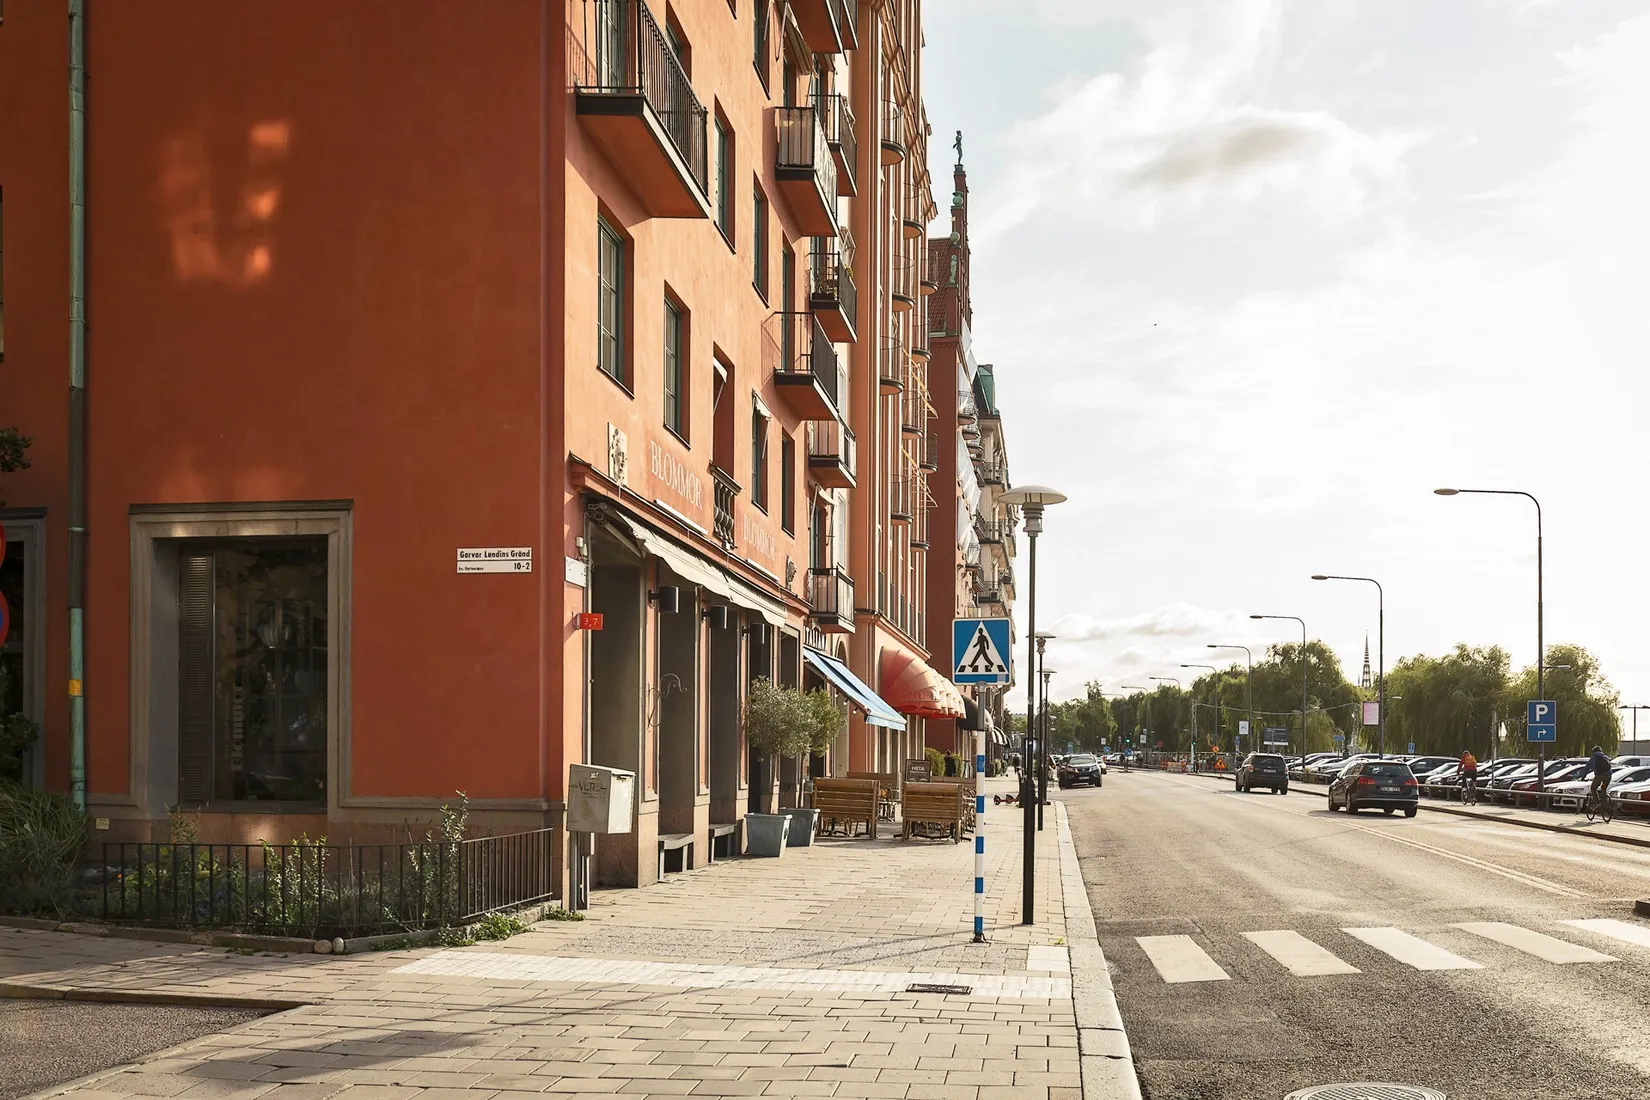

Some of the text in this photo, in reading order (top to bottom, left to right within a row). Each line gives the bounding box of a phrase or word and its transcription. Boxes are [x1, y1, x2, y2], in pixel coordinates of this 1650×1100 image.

[651, 440, 702, 511] BLOMMOR
[743, 514, 776, 562] BLOMMOR
[459, 549, 530, 558] Garvar Lundins Gränd
[514, 562, 530, 570] 10-2
[1535, 704, 1549, 721] P
